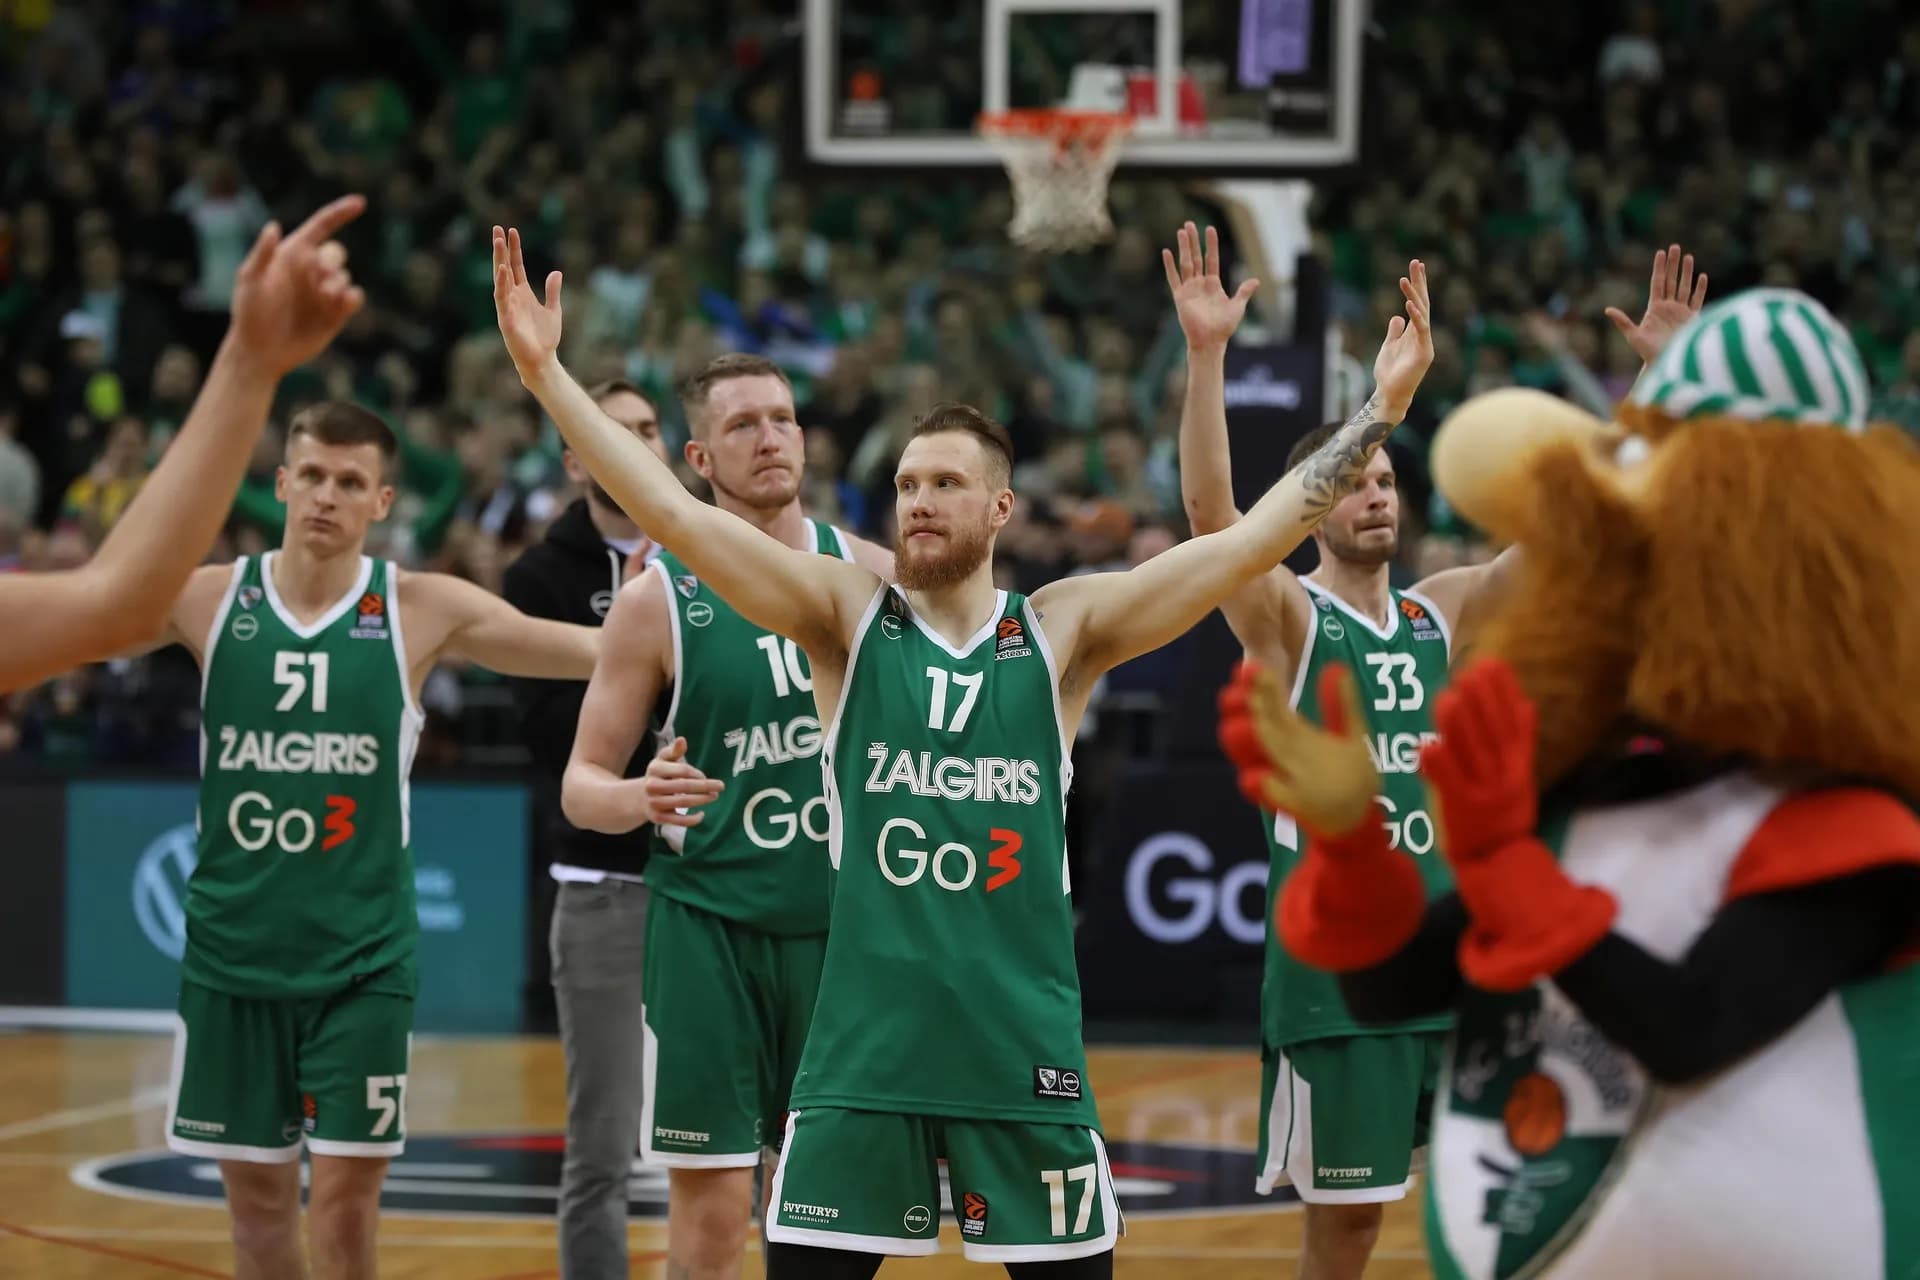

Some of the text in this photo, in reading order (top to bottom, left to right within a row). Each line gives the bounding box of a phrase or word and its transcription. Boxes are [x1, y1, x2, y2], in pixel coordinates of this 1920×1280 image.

[273, 651, 329, 712] 51
[926, 666, 984, 732] 17
[1365, 652, 1425, 711] 33
[218, 725, 380, 776] ŽALGIRIS
[865, 742, 1041, 805] ŽALGIRIS
[783, 1201, 839, 1218] ŠVYTURYS
[1041, 1163, 1096, 1236] 17
